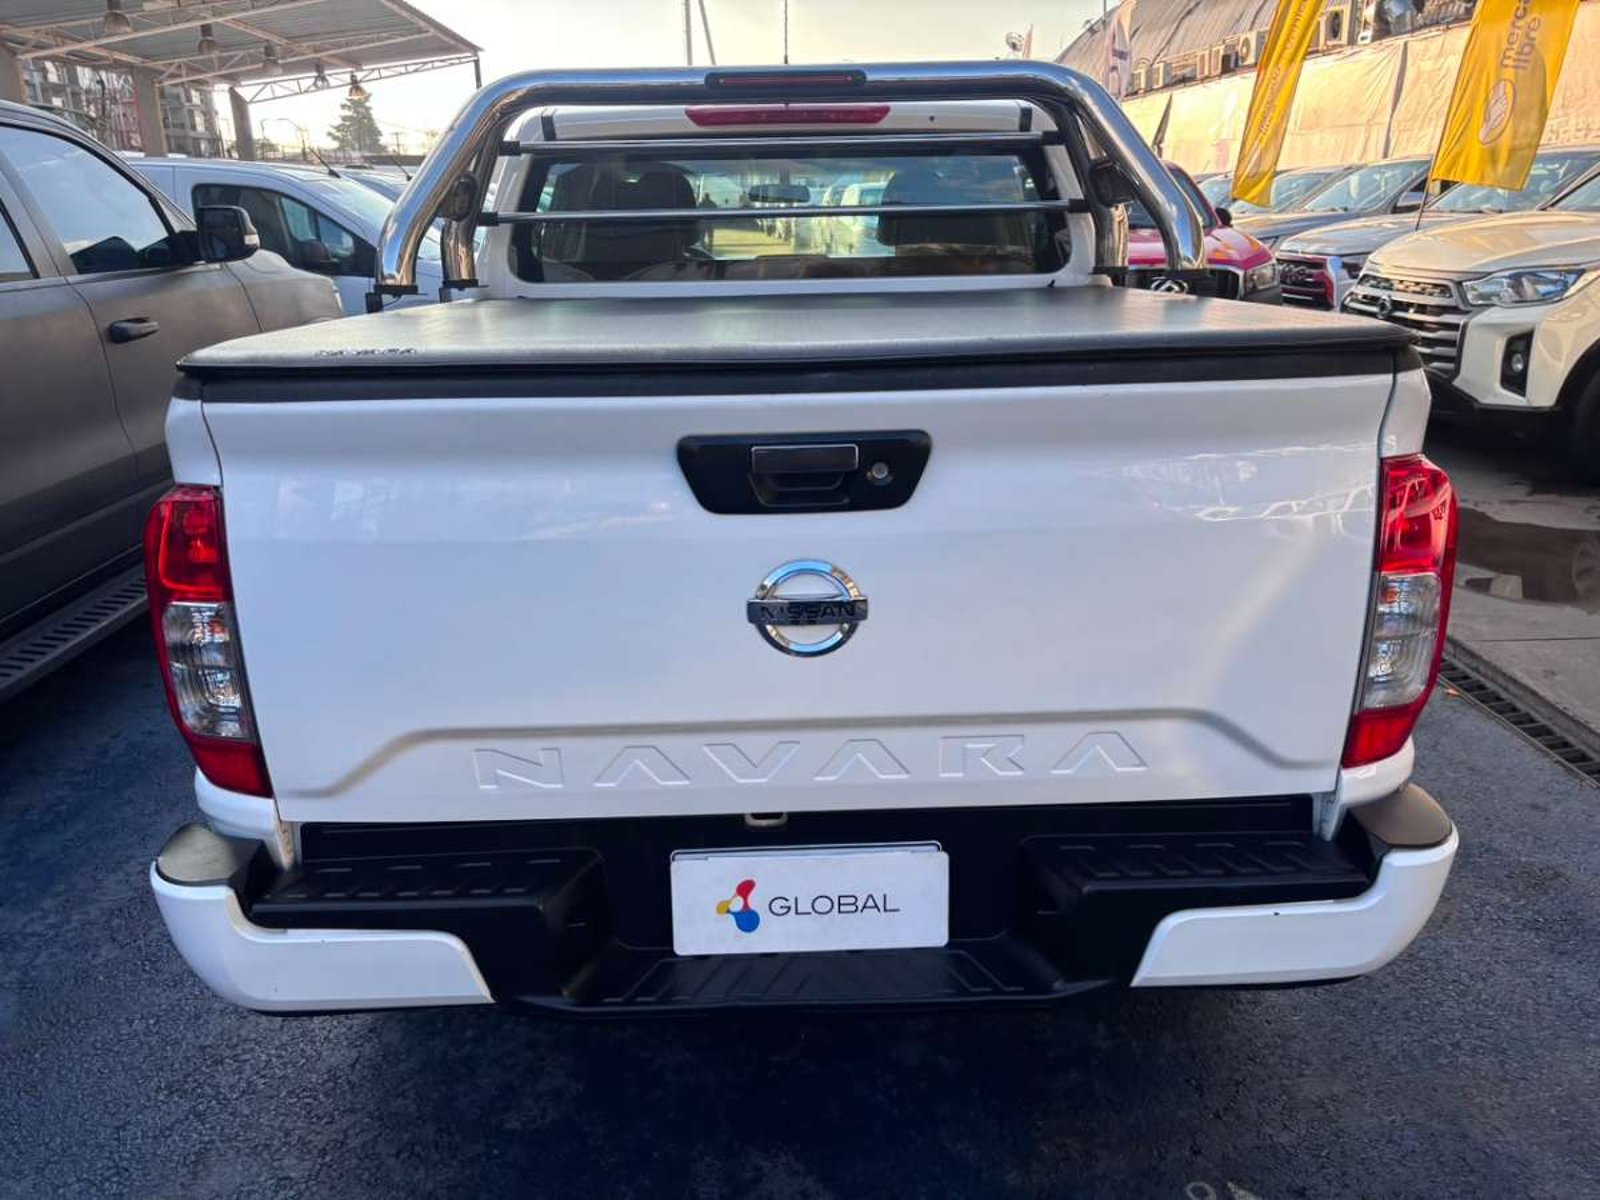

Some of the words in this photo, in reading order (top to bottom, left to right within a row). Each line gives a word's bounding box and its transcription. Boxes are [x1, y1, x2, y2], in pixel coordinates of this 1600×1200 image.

[1511, 16, 1541, 69] libre
[760, 602, 855, 620] NISSAN
[474, 731, 1149, 789] NAVARA
[768, 893, 900, 916] GLOBAL
